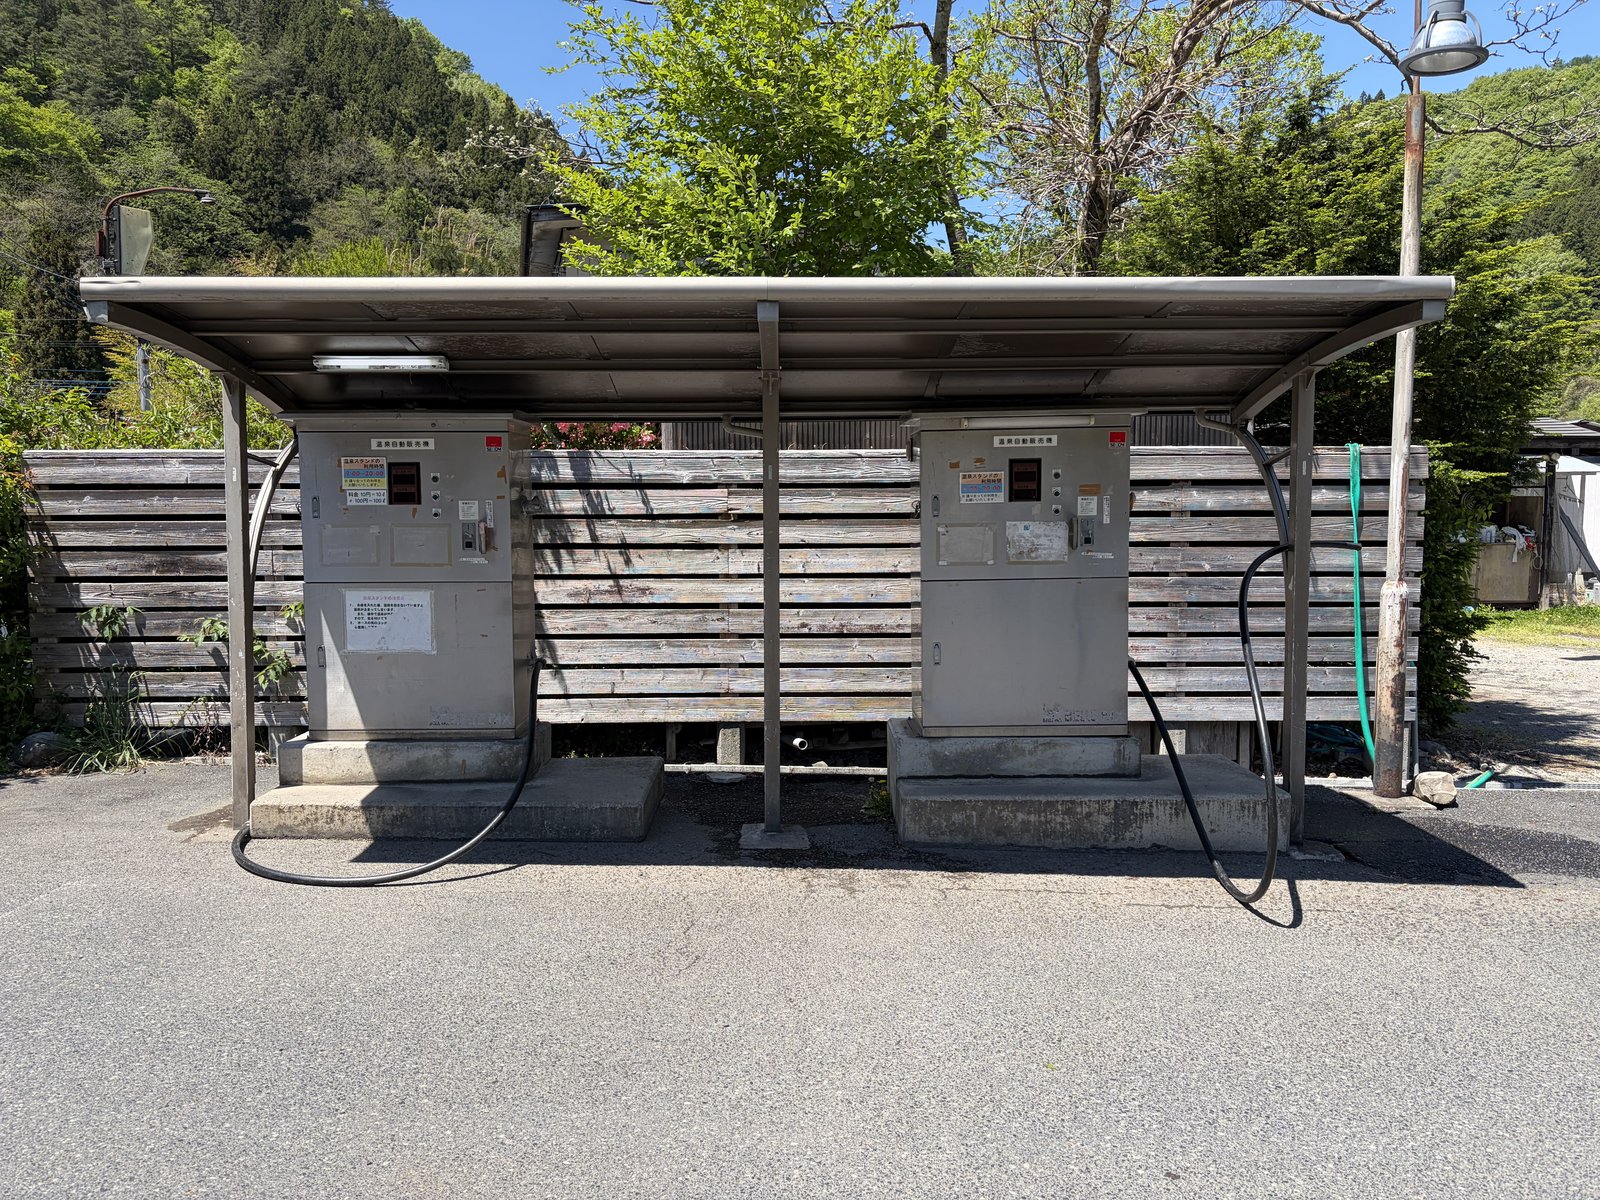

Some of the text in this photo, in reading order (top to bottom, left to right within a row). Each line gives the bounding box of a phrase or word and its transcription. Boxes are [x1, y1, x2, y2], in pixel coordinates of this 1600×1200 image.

[999, 437, 1052, 445] 温泉自動販売機
